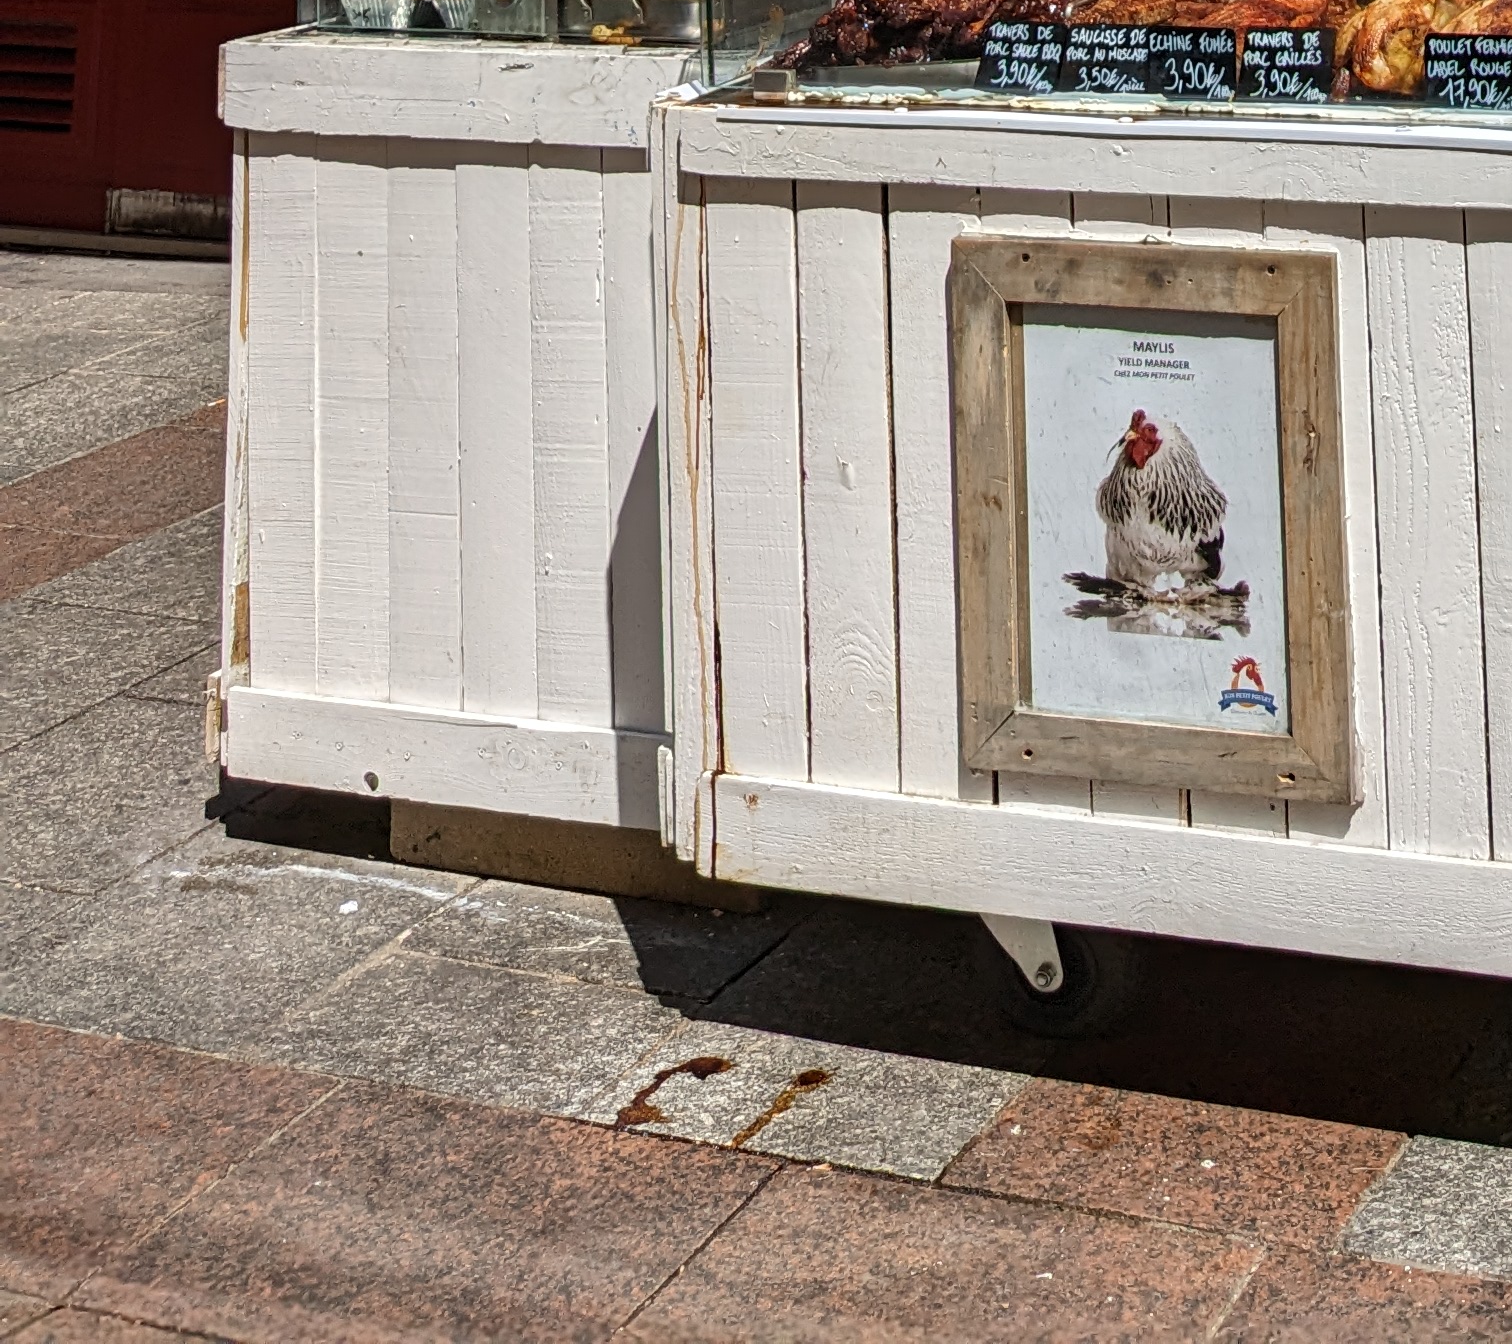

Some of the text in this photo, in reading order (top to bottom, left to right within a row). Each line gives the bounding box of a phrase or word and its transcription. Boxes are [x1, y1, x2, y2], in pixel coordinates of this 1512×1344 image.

[988, 21, 1054, 41] TRAVERS DE
[1129, 27, 1147, 46] DE
[1247, 30, 1321, 50] TRAVERS DE
[985, 40, 1062, 64] PORC SAUCE BBQ
[1066, 45, 1091, 62] PORC
[1093, 46, 1106, 62] AU
[1428, 37, 1473, 56] POULET
[1243, 50, 1271, 67] PORC
[1427, 57, 1512, 79] LABEL ROUGE
[1133, 340, 1175, 354] MAYLIS
[1118, 356, 1190, 370] YIELD MANAGER
[1169, 372, 1196, 381] POULET
